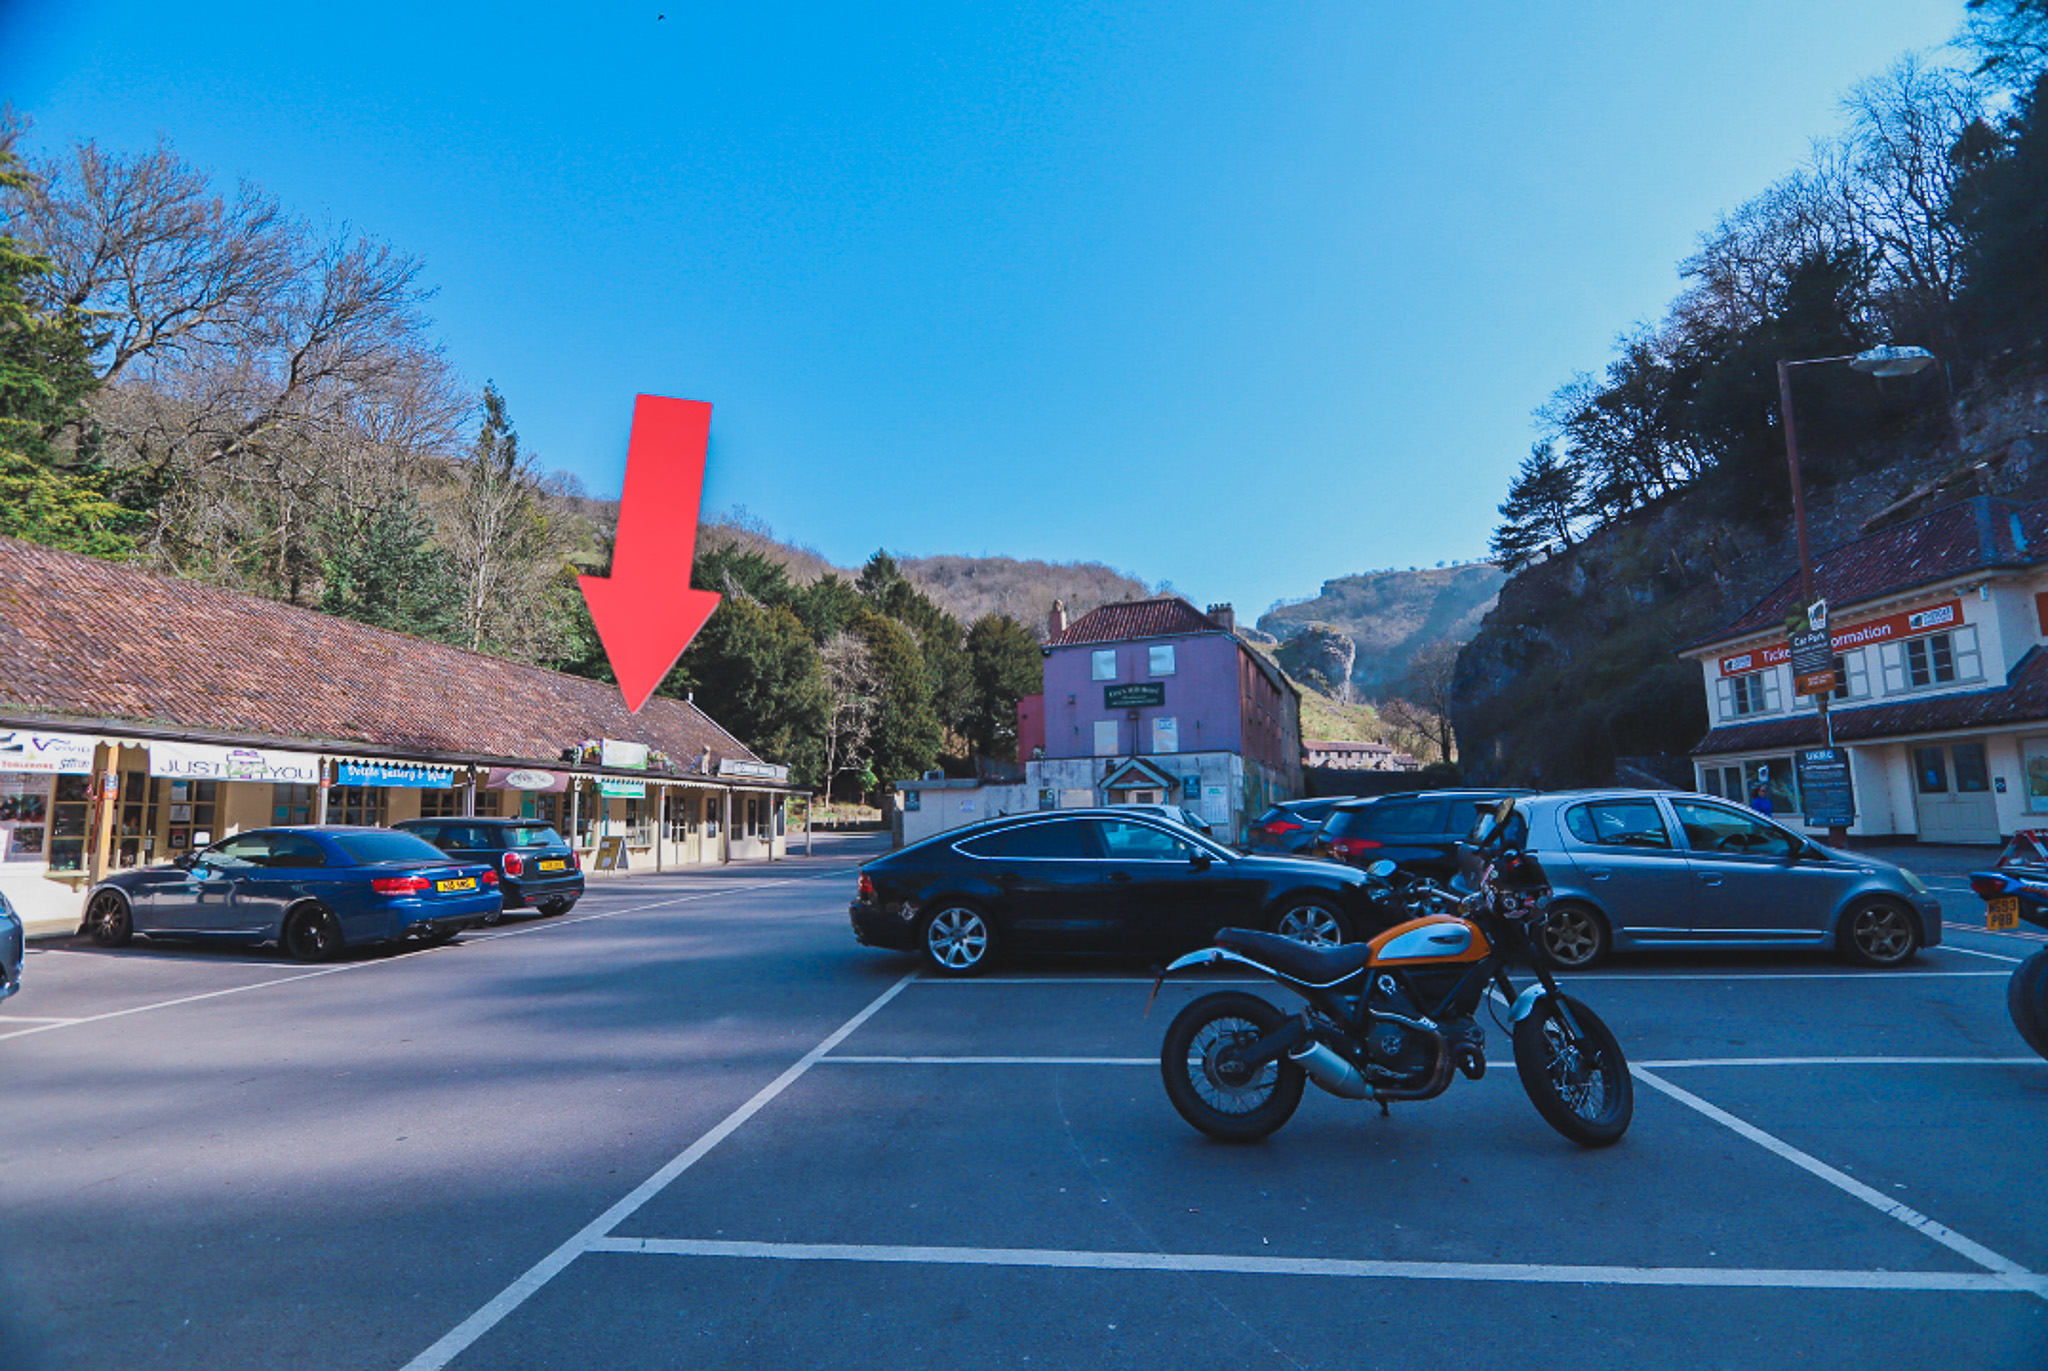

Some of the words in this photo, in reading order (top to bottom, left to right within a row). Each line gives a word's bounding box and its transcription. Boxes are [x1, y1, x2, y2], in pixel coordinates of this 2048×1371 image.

[1762, 647, 1792, 663] Ticke
[1831, 624, 1892, 648] ormation
[2, 760, 54, 770] TOBLERONE
[160, 759, 220, 775] JUST
[231, 763, 266, 775] FOR
[269, 766, 313, 779] YOU
